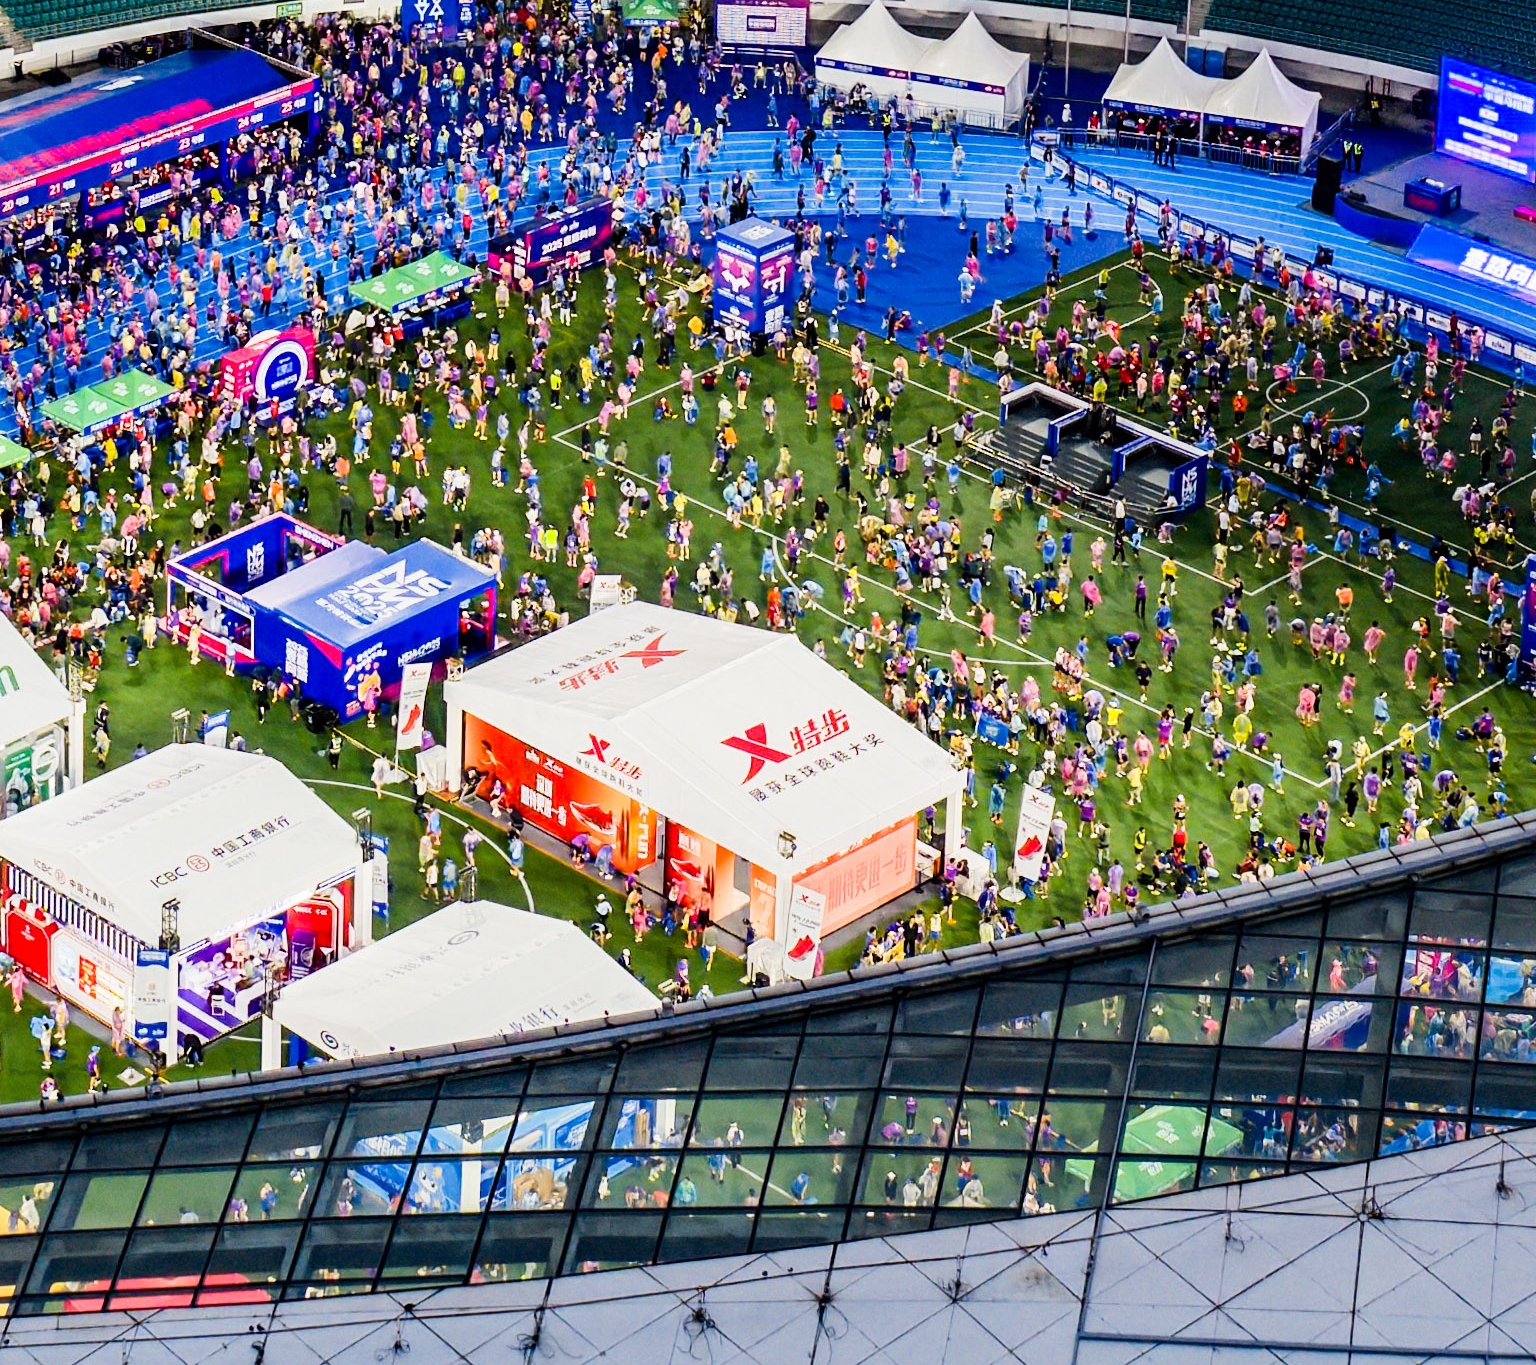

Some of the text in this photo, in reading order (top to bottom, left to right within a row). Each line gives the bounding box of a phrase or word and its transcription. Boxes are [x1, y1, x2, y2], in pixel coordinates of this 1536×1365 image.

[789, 709, 850, 755] 特步
[150, 816, 291, 890] ICBC 中国工商银行
[495, 1005, 559, 1038] 业银行
